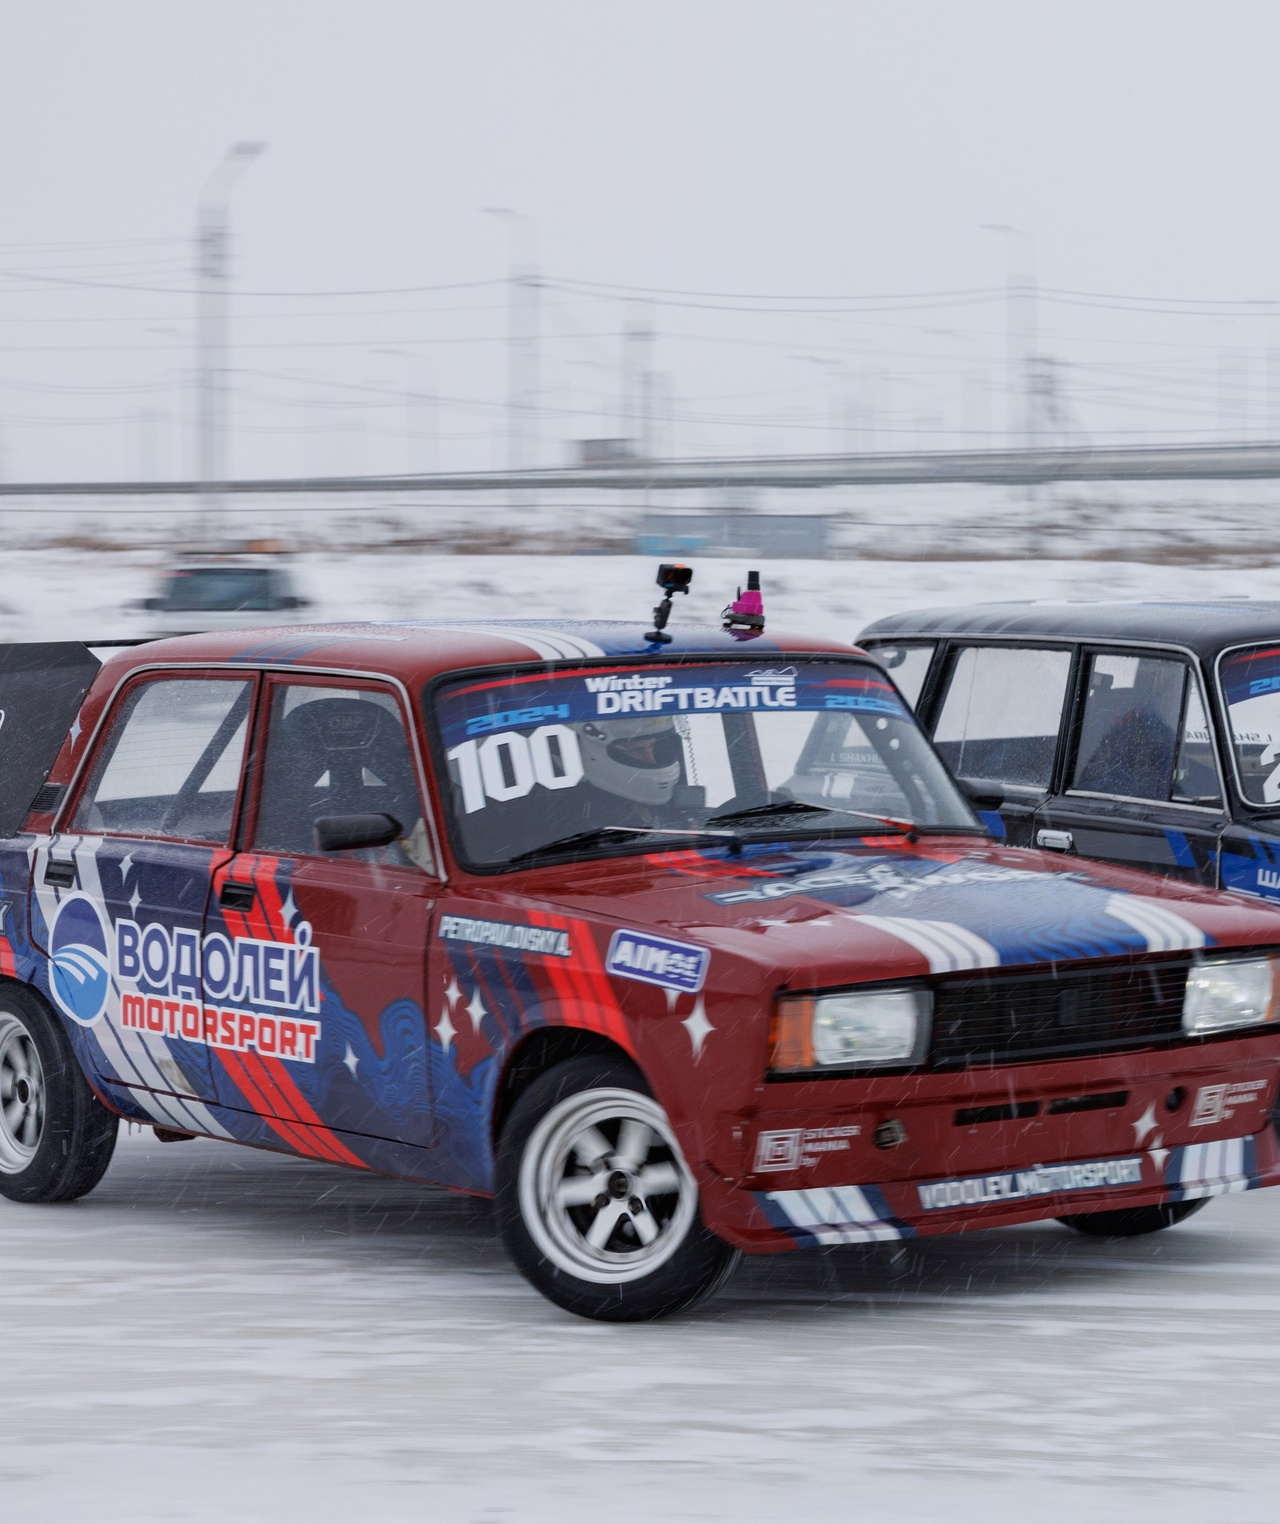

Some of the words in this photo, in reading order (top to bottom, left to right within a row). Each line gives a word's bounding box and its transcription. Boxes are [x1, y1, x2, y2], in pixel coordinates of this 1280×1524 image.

[585, 675, 672, 693] Winter
[597, 686, 797, 714] DRIFTBATTLE
[466, 704, 570, 735] 2024
[448, 724, 584, 814] 100
[116, 921, 319, 1012] ВОДОЛЕЙ
[121, 991, 320, 1062] MOTORSPORT
